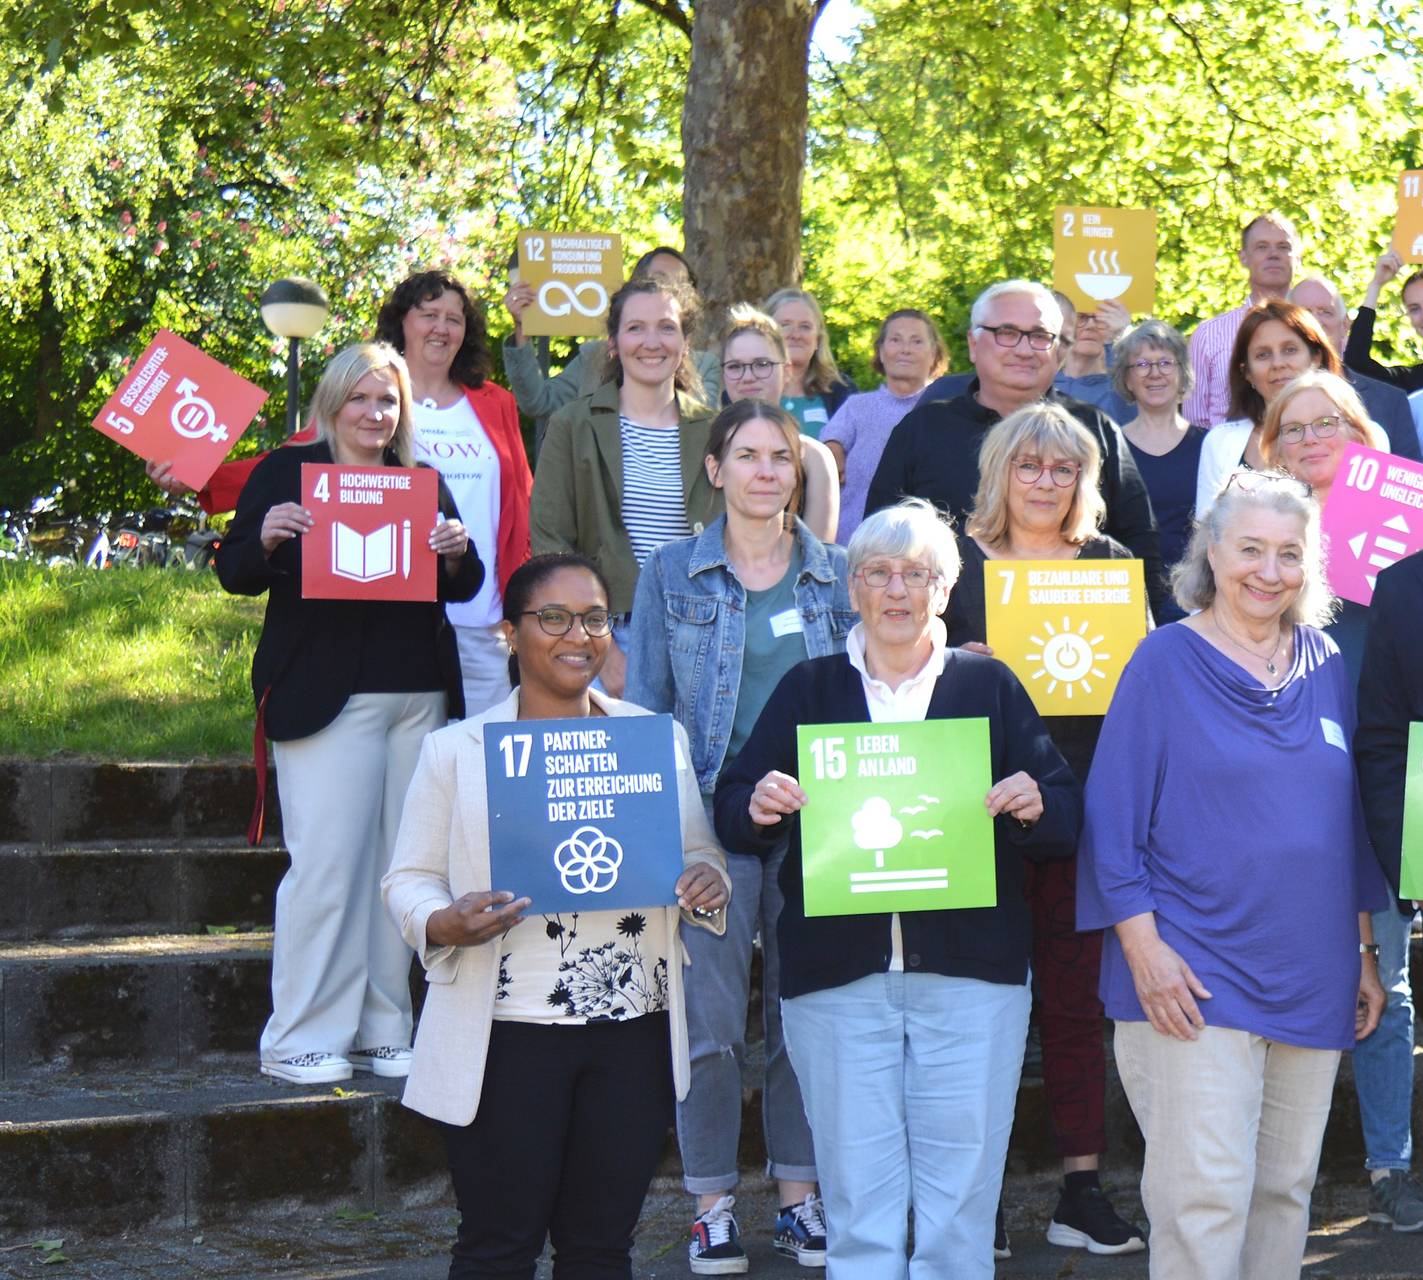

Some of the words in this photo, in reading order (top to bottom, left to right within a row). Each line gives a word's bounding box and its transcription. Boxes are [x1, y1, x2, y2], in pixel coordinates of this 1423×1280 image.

[1404, 176, 1419, 198] 11
[1063, 213, 1074, 237] 2
[1082, 214, 1100, 225] KEIN
[1082, 226, 1113, 239] HUNGER
[525, 237, 545, 262] 12
[551, 250, 585, 262] KONSUM
[585, 251, 602, 262] UND
[552, 263, 602, 275] PRODUKTION
[105, 411, 135, 436] 5
[340, 473, 411, 490] HOCHWERTIGE
[1346, 455, 1380, 492] 10
[314, 473, 330, 503] 4
[340, 490, 383, 504] BILDUNG
[999, 570, 1015, 605] 7
[1028, 570, 1104, 586] BEZAHLBARE
[1104, 570, 1129, 585] UND
[1029, 589, 1082, 604] SAUBERE
[1083, 589, 1131, 604] ENERGIE
[543, 730, 612, 751] PARTNER-
[856, 735, 899, 755] LEBEN
[499, 734, 533, 778] 17
[545, 753, 618, 775] SCHAFTEN
[810, 737, 847, 780] 15
[858, 758, 878, 777] AN
[879, 756, 917, 776] LAND
[547, 778, 576, 799] ZUR
[577, 773, 663, 797] ERREICHUNG
[549, 802, 577, 822] DER
[578, 799, 615, 820] ZIELE
